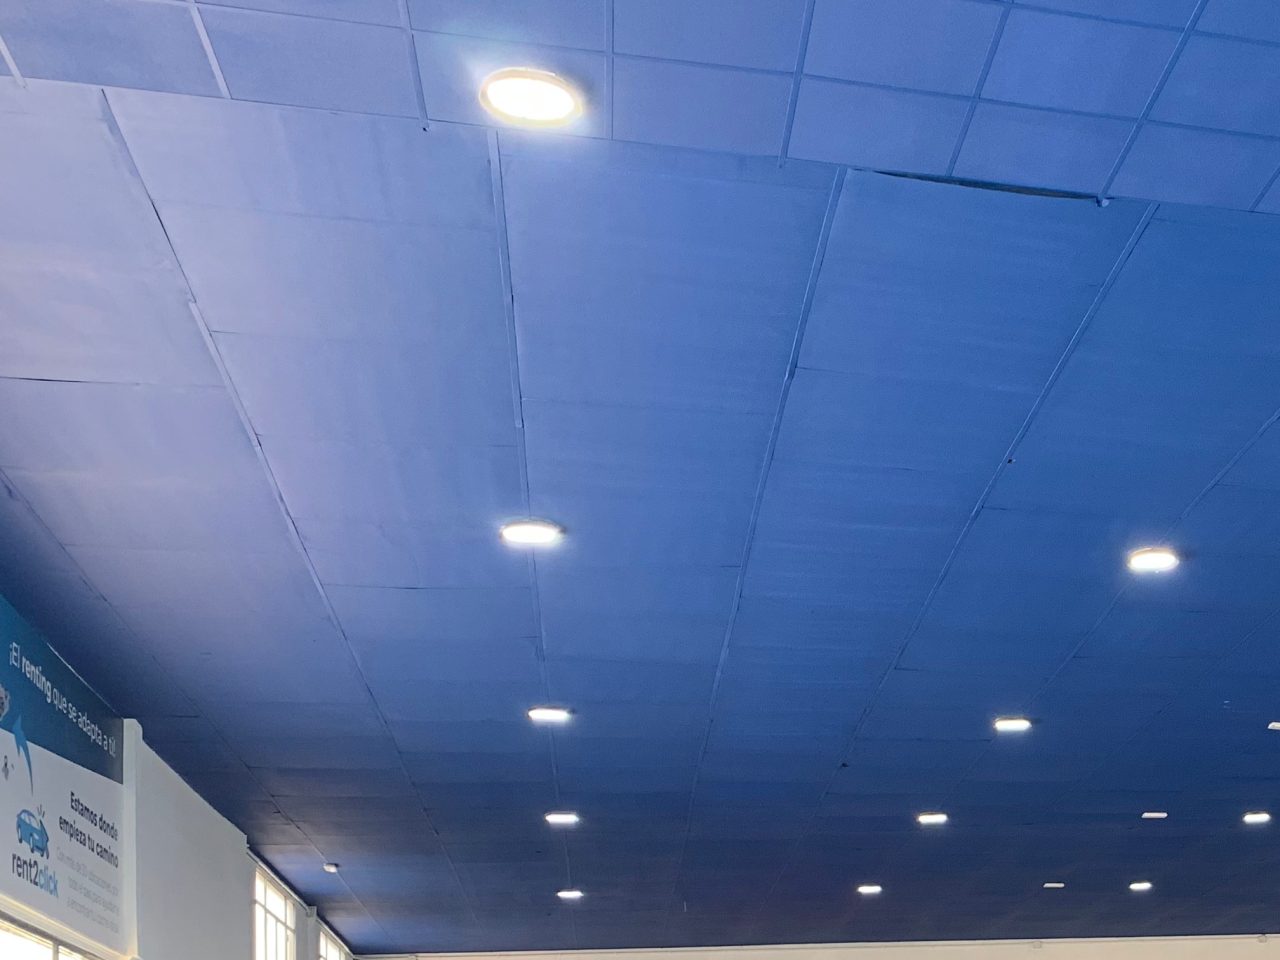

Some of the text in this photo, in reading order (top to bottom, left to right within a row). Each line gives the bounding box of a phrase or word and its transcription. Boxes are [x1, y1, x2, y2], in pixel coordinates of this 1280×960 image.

[9, 641, 20, 668] ¡El
[22, 655, 51, 704] renting
[52, 687, 68, 712] que
[68, 702, 77, 722] se
[77, 711, 103, 745] adapta
[103, 734, 108, 751] a
[70, 791, 119, 841] Estamos donde
[59, 816, 119, 868] empieza tu camino
[12, 853, 59, 898] rent2click
